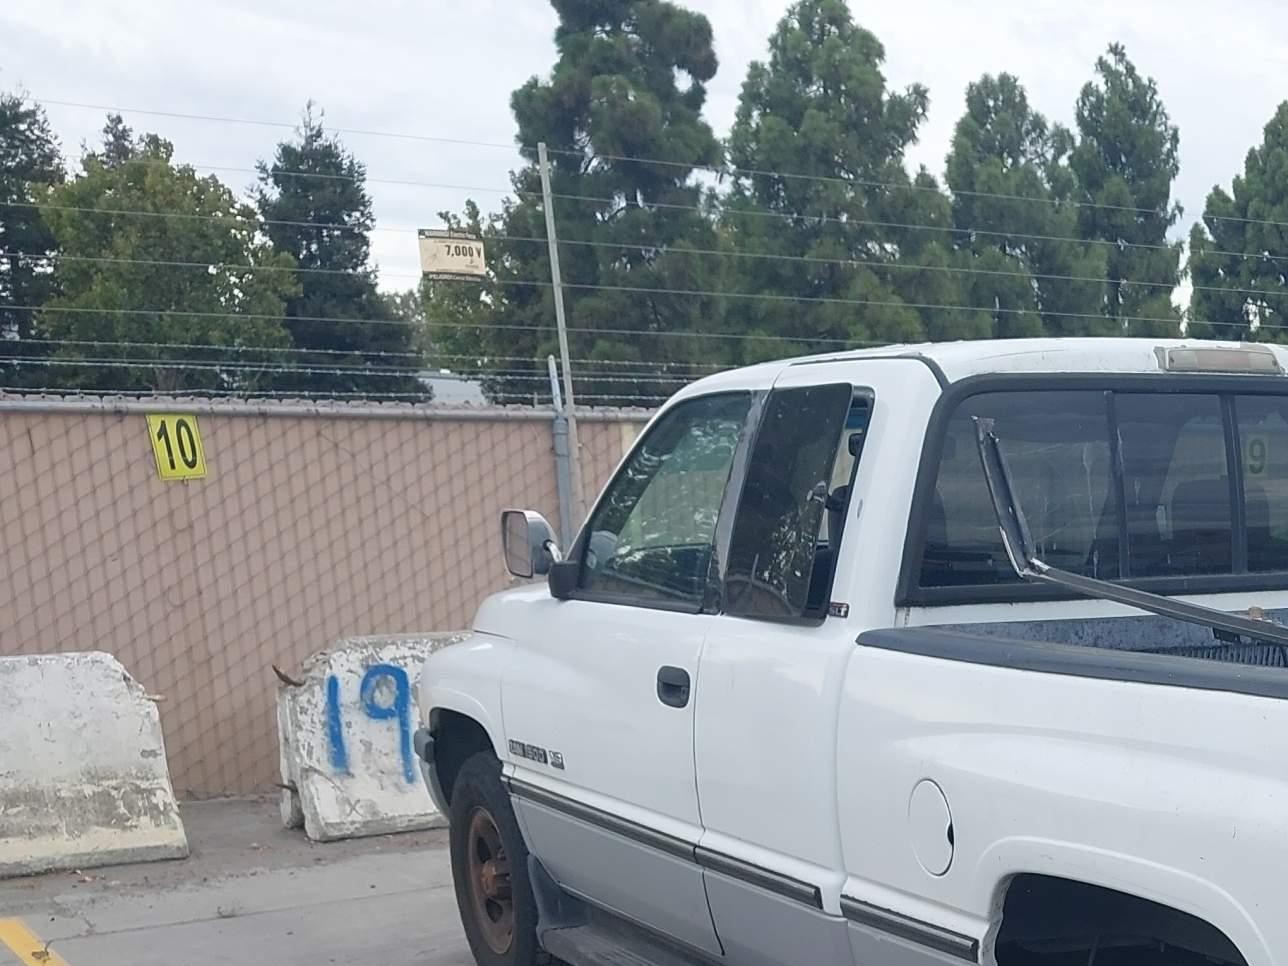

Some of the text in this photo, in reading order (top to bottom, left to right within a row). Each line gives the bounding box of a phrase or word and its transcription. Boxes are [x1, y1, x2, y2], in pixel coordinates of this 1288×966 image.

[157, 419, 197, 469] 10
[1249, 438, 1266, 474] 9
[326, 663, 416, 784] 19
